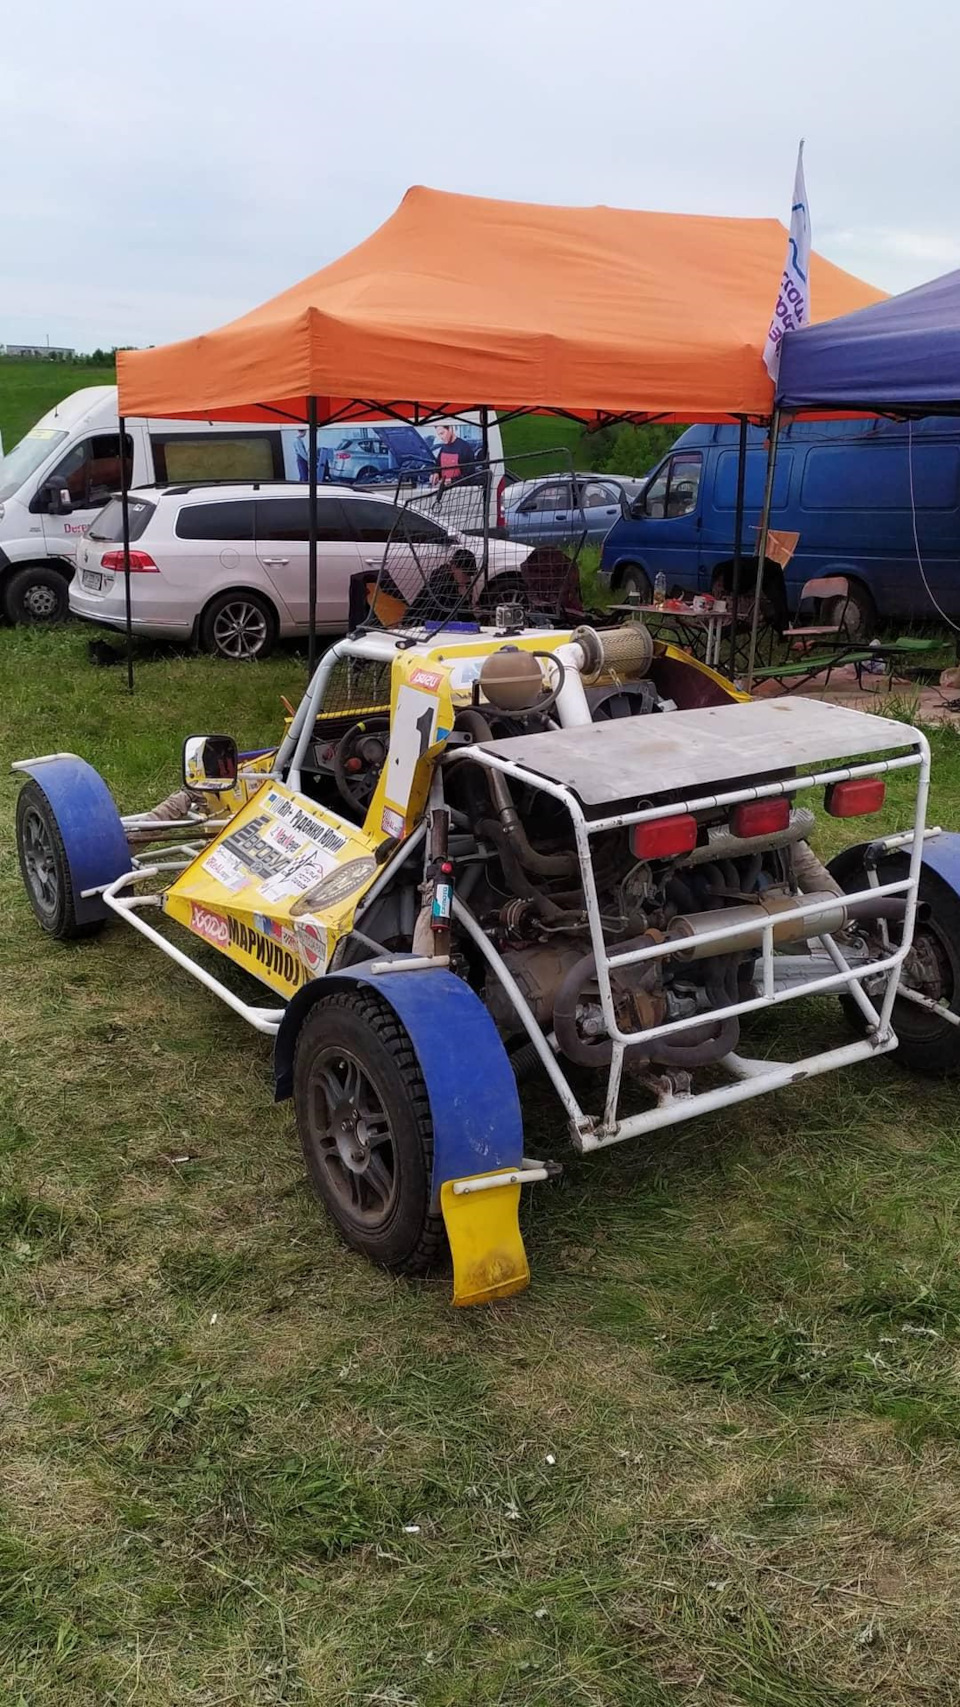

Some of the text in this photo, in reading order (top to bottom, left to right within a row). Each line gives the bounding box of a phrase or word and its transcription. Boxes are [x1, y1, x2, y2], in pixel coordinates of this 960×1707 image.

[416, 706, 435, 760] 1
[289, 809, 325, 841] Руденко
[317, 827, 348, 853] Юрий
